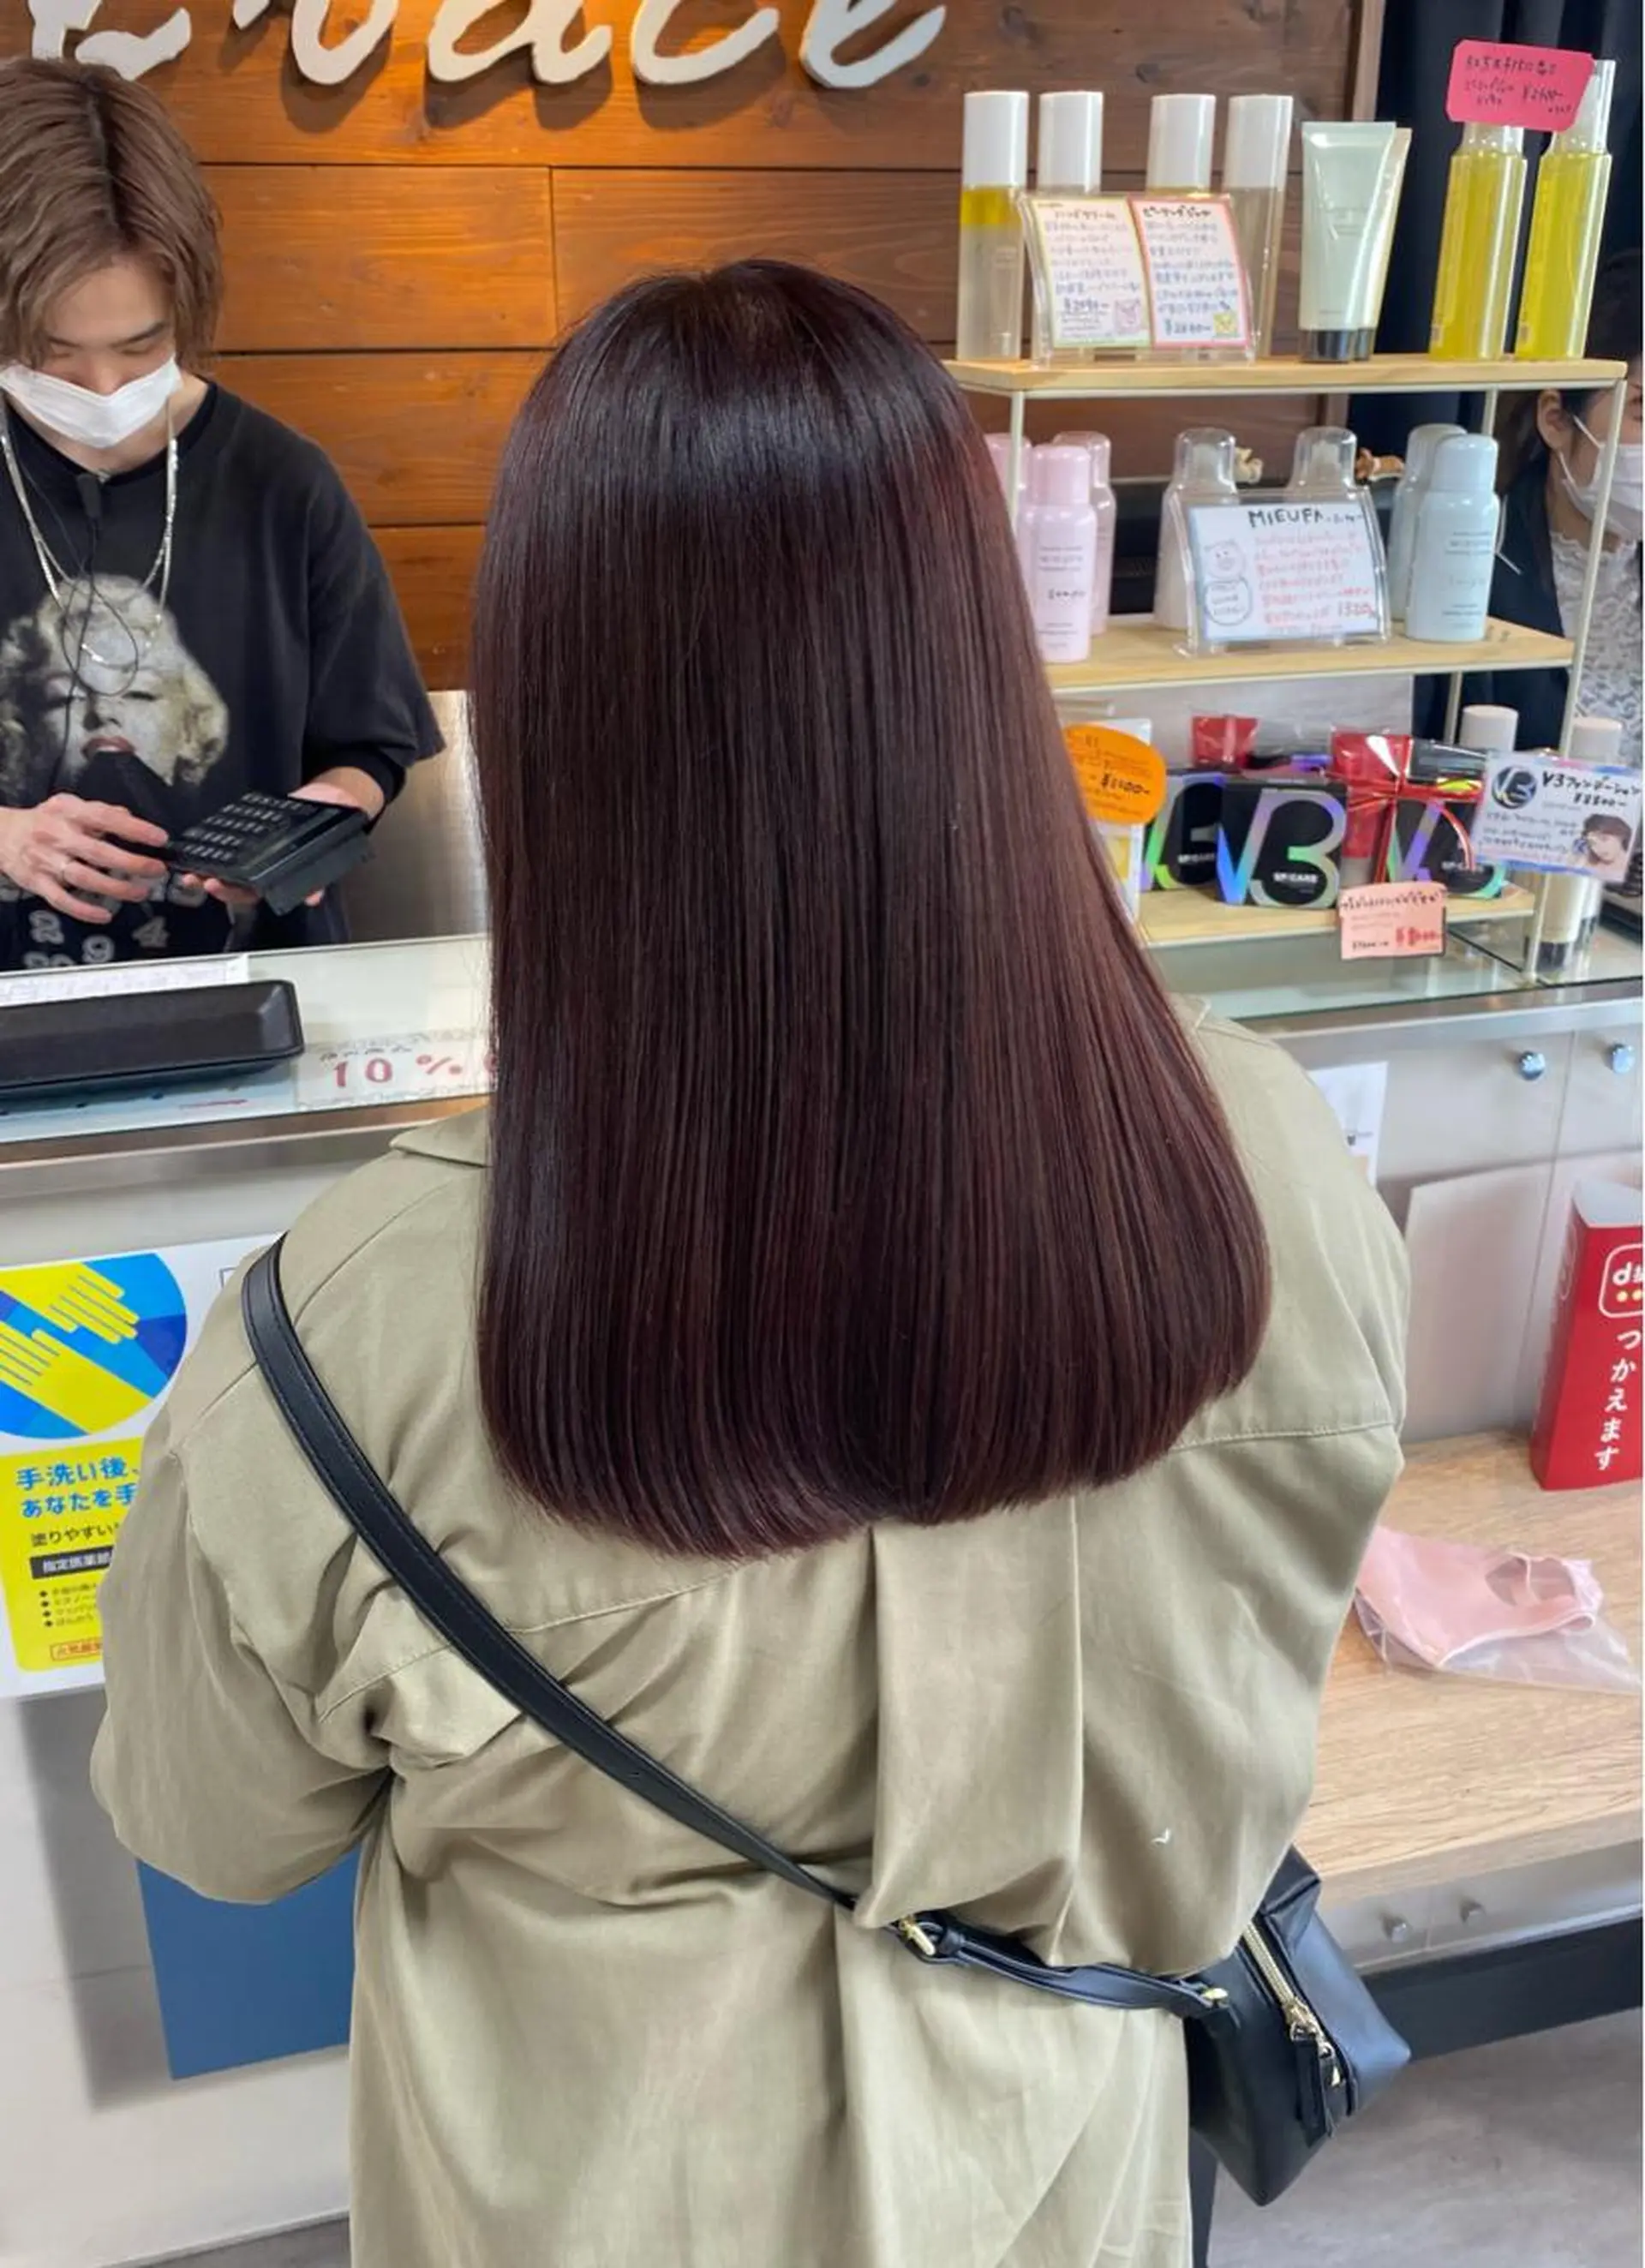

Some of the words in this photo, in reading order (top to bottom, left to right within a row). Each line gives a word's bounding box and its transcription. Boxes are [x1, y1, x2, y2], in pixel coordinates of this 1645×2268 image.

[1594, 1329, 1642, 1471] つかえます
[15, 1454, 141, 1492] 手洗い後、
[21, 1481, 138, 1519] あなたを手
[31, 1522, 118, 1547] 塗りやすい
